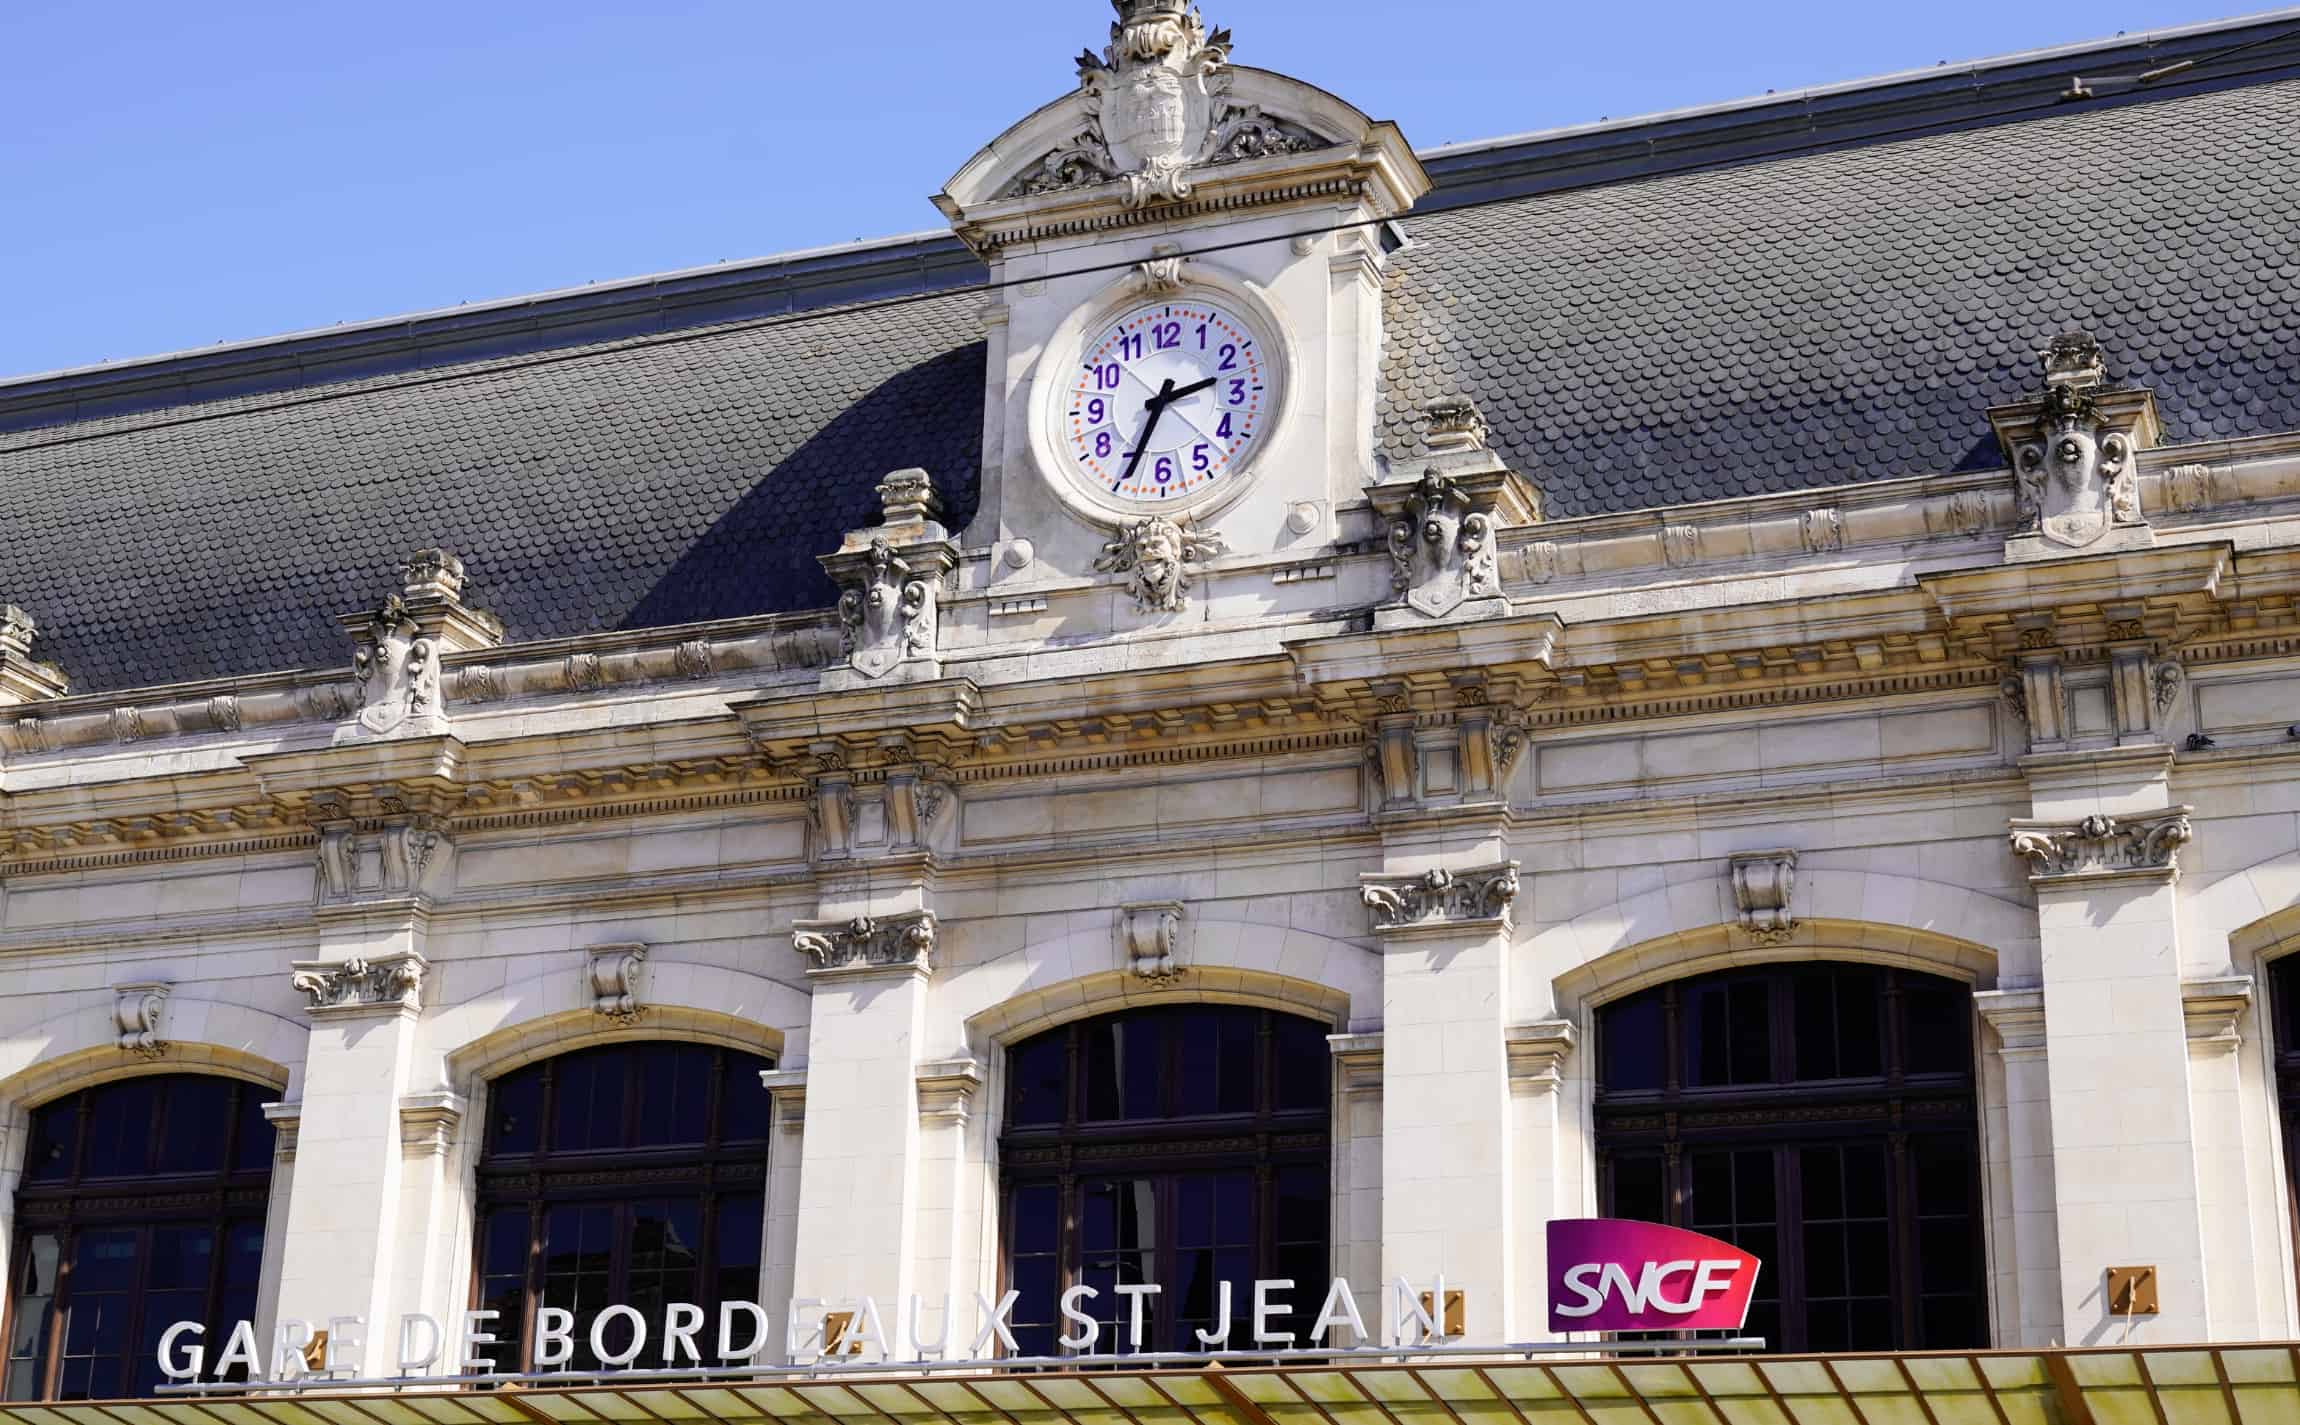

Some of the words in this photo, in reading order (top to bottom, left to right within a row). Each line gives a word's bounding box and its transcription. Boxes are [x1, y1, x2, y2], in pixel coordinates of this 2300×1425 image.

[1119, 334, 1141, 361] 11
[1151, 322, 1181, 349] 12
[1195, 324, 1207, 349] 1
[1218, 344, 1237, 371] 2
[1092, 363, 1120, 390] 10
[1228, 379, 1245, 405] 3
[1087, 398, 1105, 424] 9
[1216, 412, 1233, 439] 4
[1095, 432, 1111, 458] 8
[1192, 444, 1209, 470] 5
[1154, 457, 1172, 484] 6
[1555, 1260, 1741, 1317] SNCF
[157, 1317, 366, 1377] GARE
[400, 1311, 500, 1368] DE
[533, 1289, 1020, 1365] BORDEAUX
[1058, 1284, 1161, 1349] ST
[1195, 1274, 1445, 1344] JEAN
